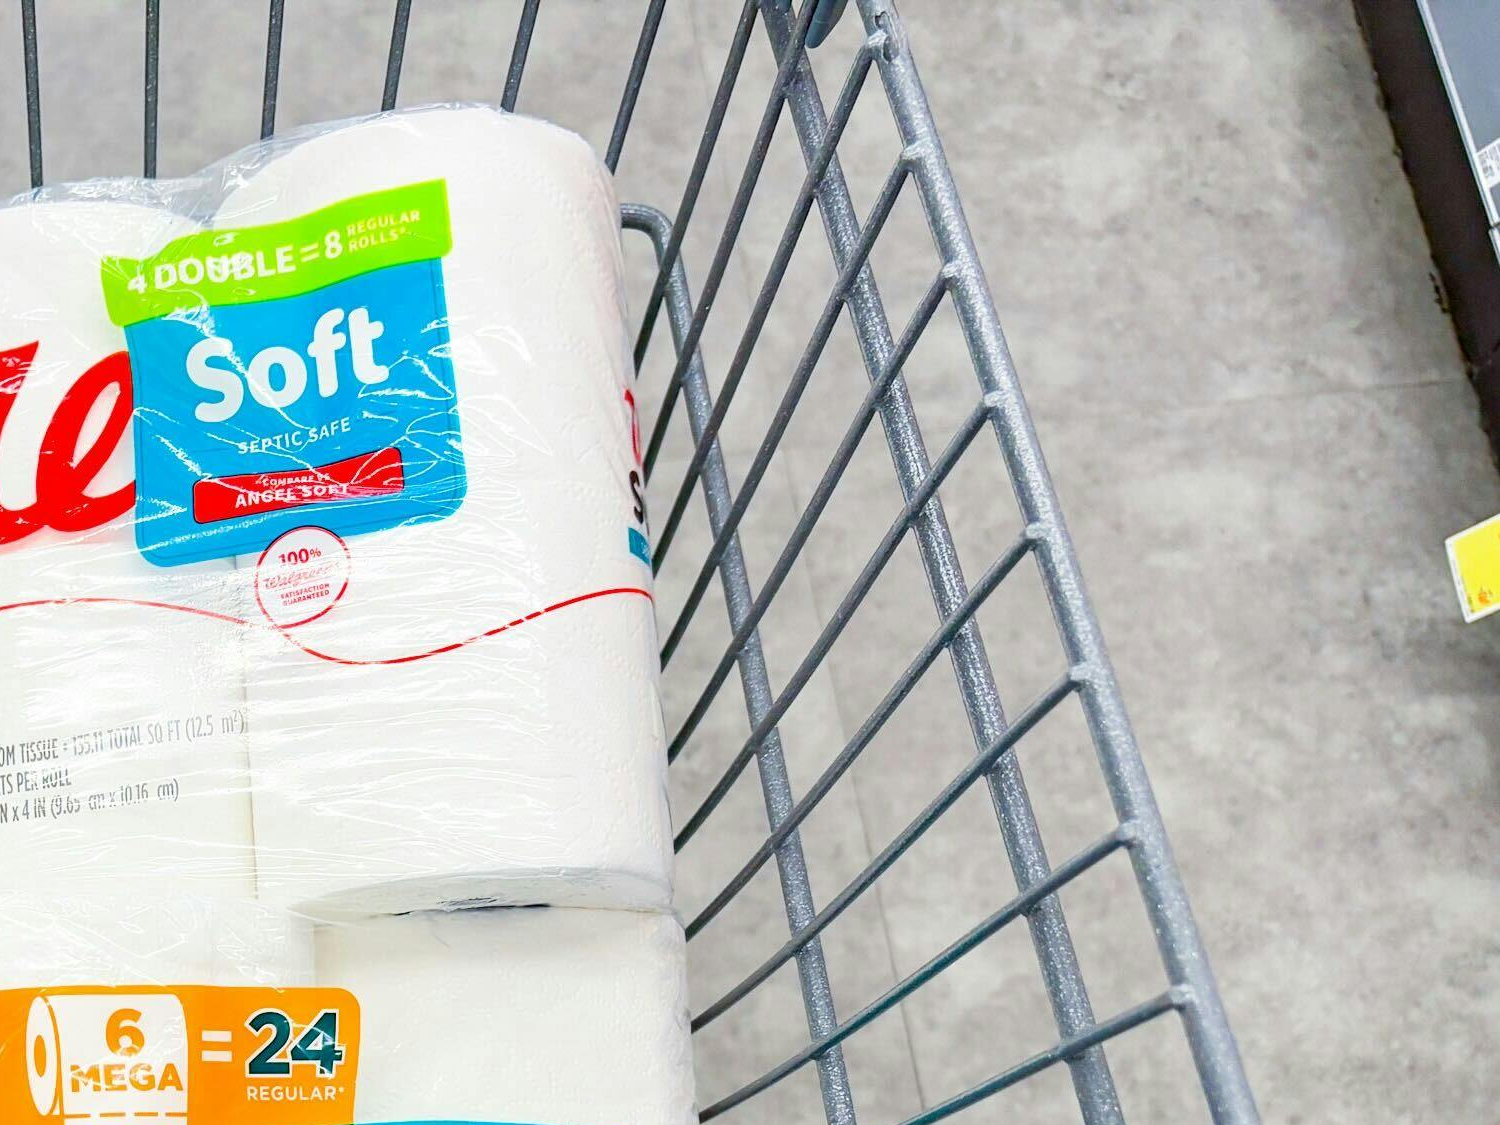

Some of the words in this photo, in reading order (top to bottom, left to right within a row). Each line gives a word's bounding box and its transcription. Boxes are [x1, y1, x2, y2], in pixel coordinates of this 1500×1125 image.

[347, 210, 420, 237] REGULAR
[127, 274, 147, 294] 4
[186, 307, 389, 422] Soft
[238, 431, 303, 454] SEPTIC
[308, 417, 351, 443] SAFE
[235, 488, 296, 509] ANGEL
[300, 483, 348, 498] SOFT
[278, 547, 322, 565] 100%
[19, 738, 59, 763] TISSUE
[107, 724, 143, 750] TOTAL
[147, 721, 163, 744] SQ
[167, 719, 181, 741] FT
[185, 715, 213, 741] (12.5
[17, 770, 39, 792] PER
[42, 766, 72, 790] ROLL
[22, 799, 30, 820] 4
[33, 796, 46, 818] IN
[157, 778, 179, 802] cm)
[105, 1008, 145, 1058] 6
[244, 1008, 345, 1078] 24
[70, 1061, 184, 1093] MEGA
